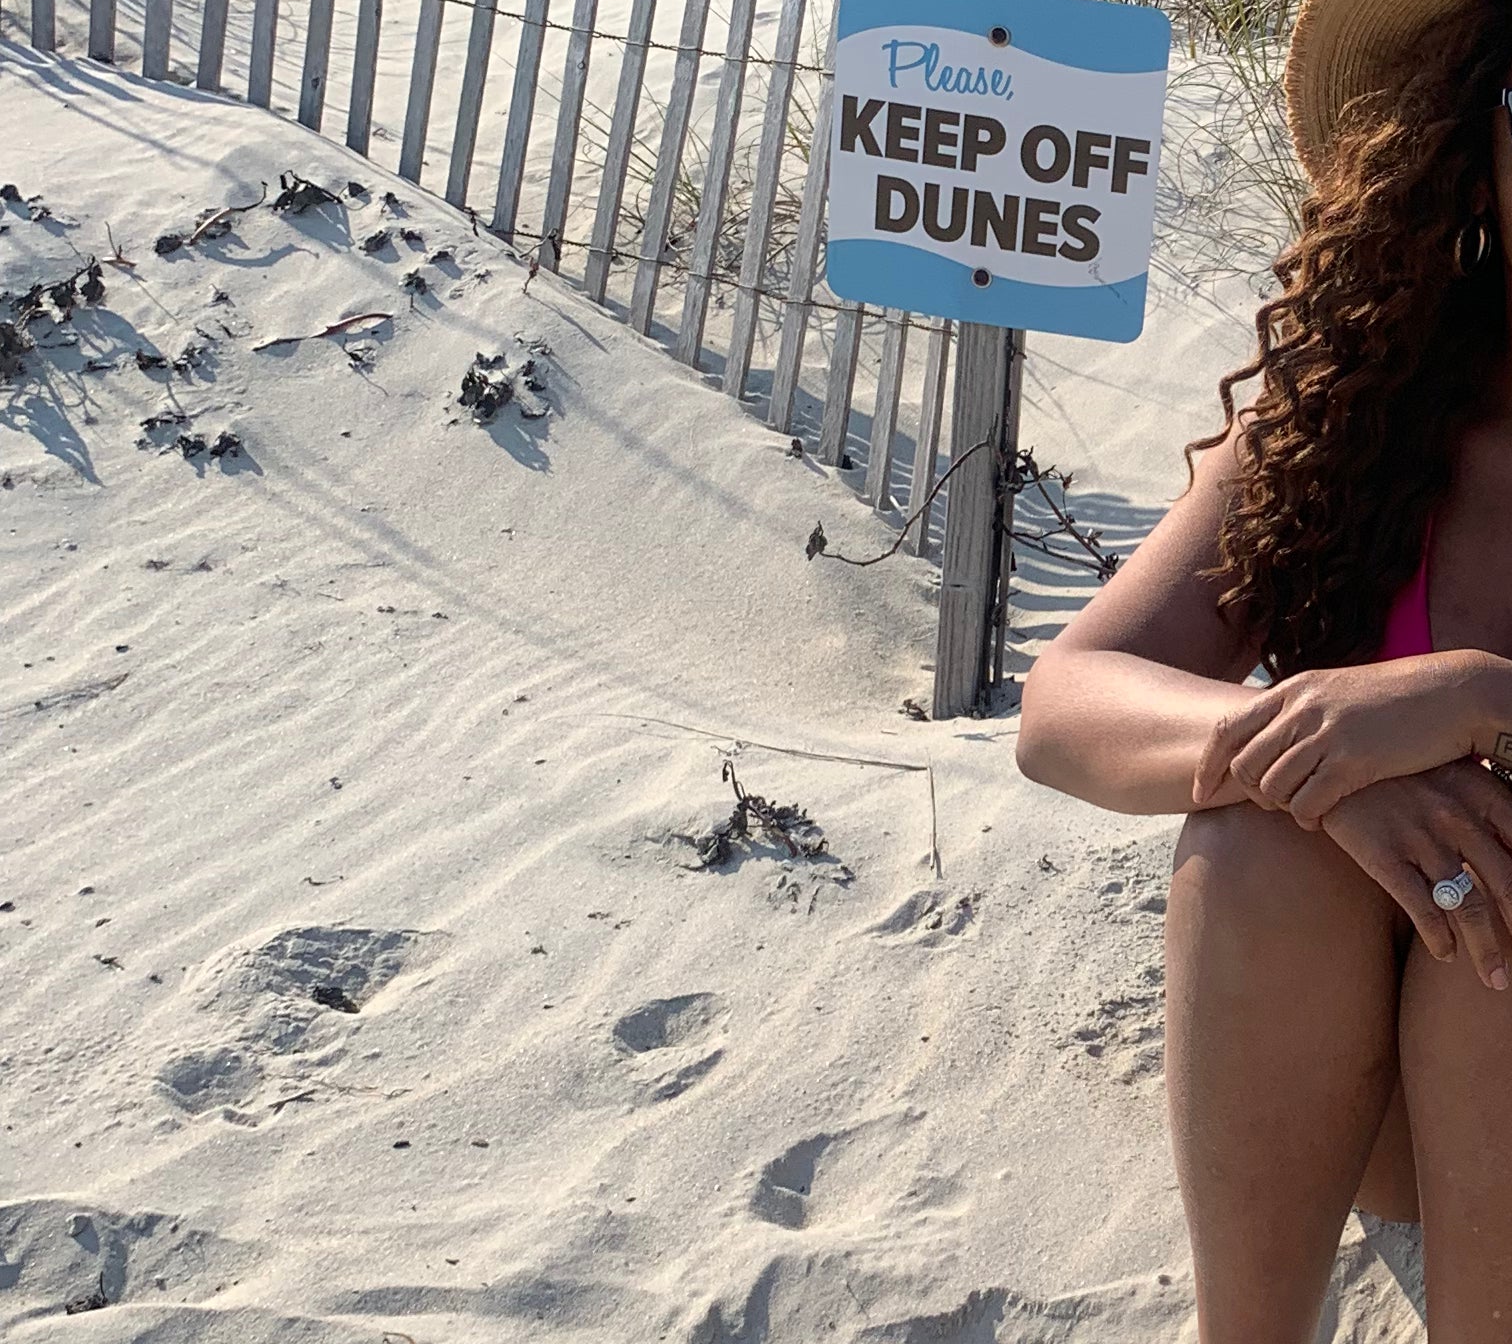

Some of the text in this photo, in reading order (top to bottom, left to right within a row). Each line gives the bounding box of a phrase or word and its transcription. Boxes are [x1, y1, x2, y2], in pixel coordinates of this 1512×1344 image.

[881, 39, 1015, 101] Please,
[839, 94, 1152, 195] KEEP OFF
[874, 174, 1102, 263] DUNES
